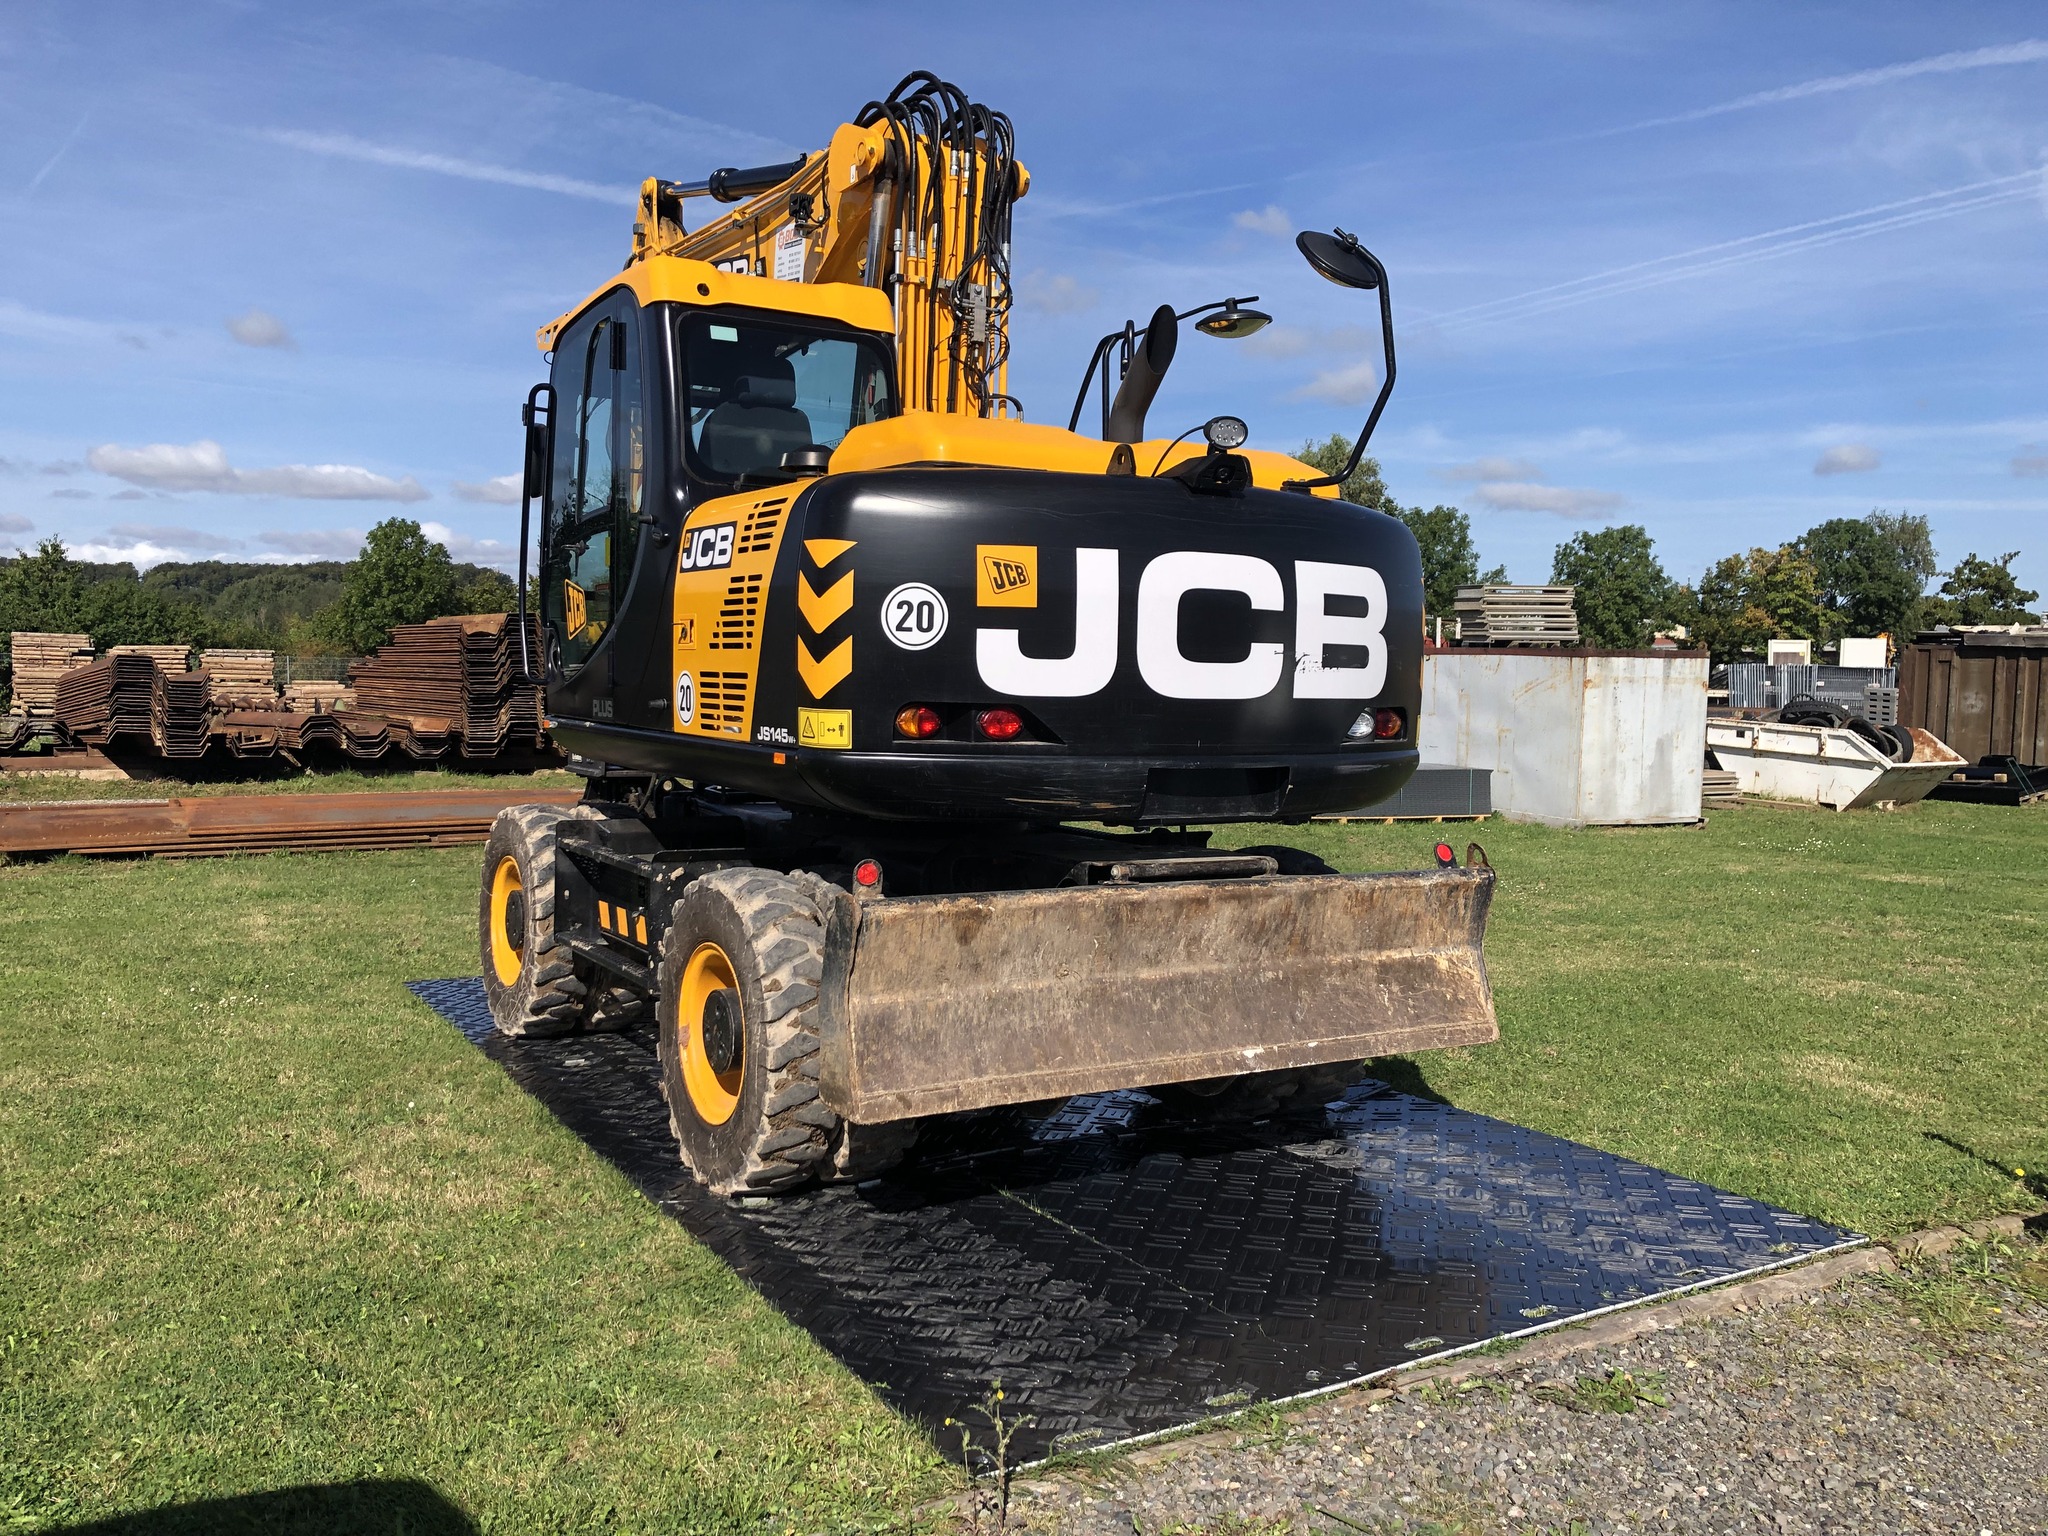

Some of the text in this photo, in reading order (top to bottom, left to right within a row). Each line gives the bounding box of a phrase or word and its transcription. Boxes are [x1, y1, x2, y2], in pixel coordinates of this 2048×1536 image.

[681, 526, 735, 569] JCB
[992, 560, 1027, 590] JCB
[568, 586, 584, 633] JCB
[895, 600, 935, 633] 20
[976, 547, 1388, 699] JCB
[592, 699, 614, 718] PLUS
[680, 685, 691, 712] 20
